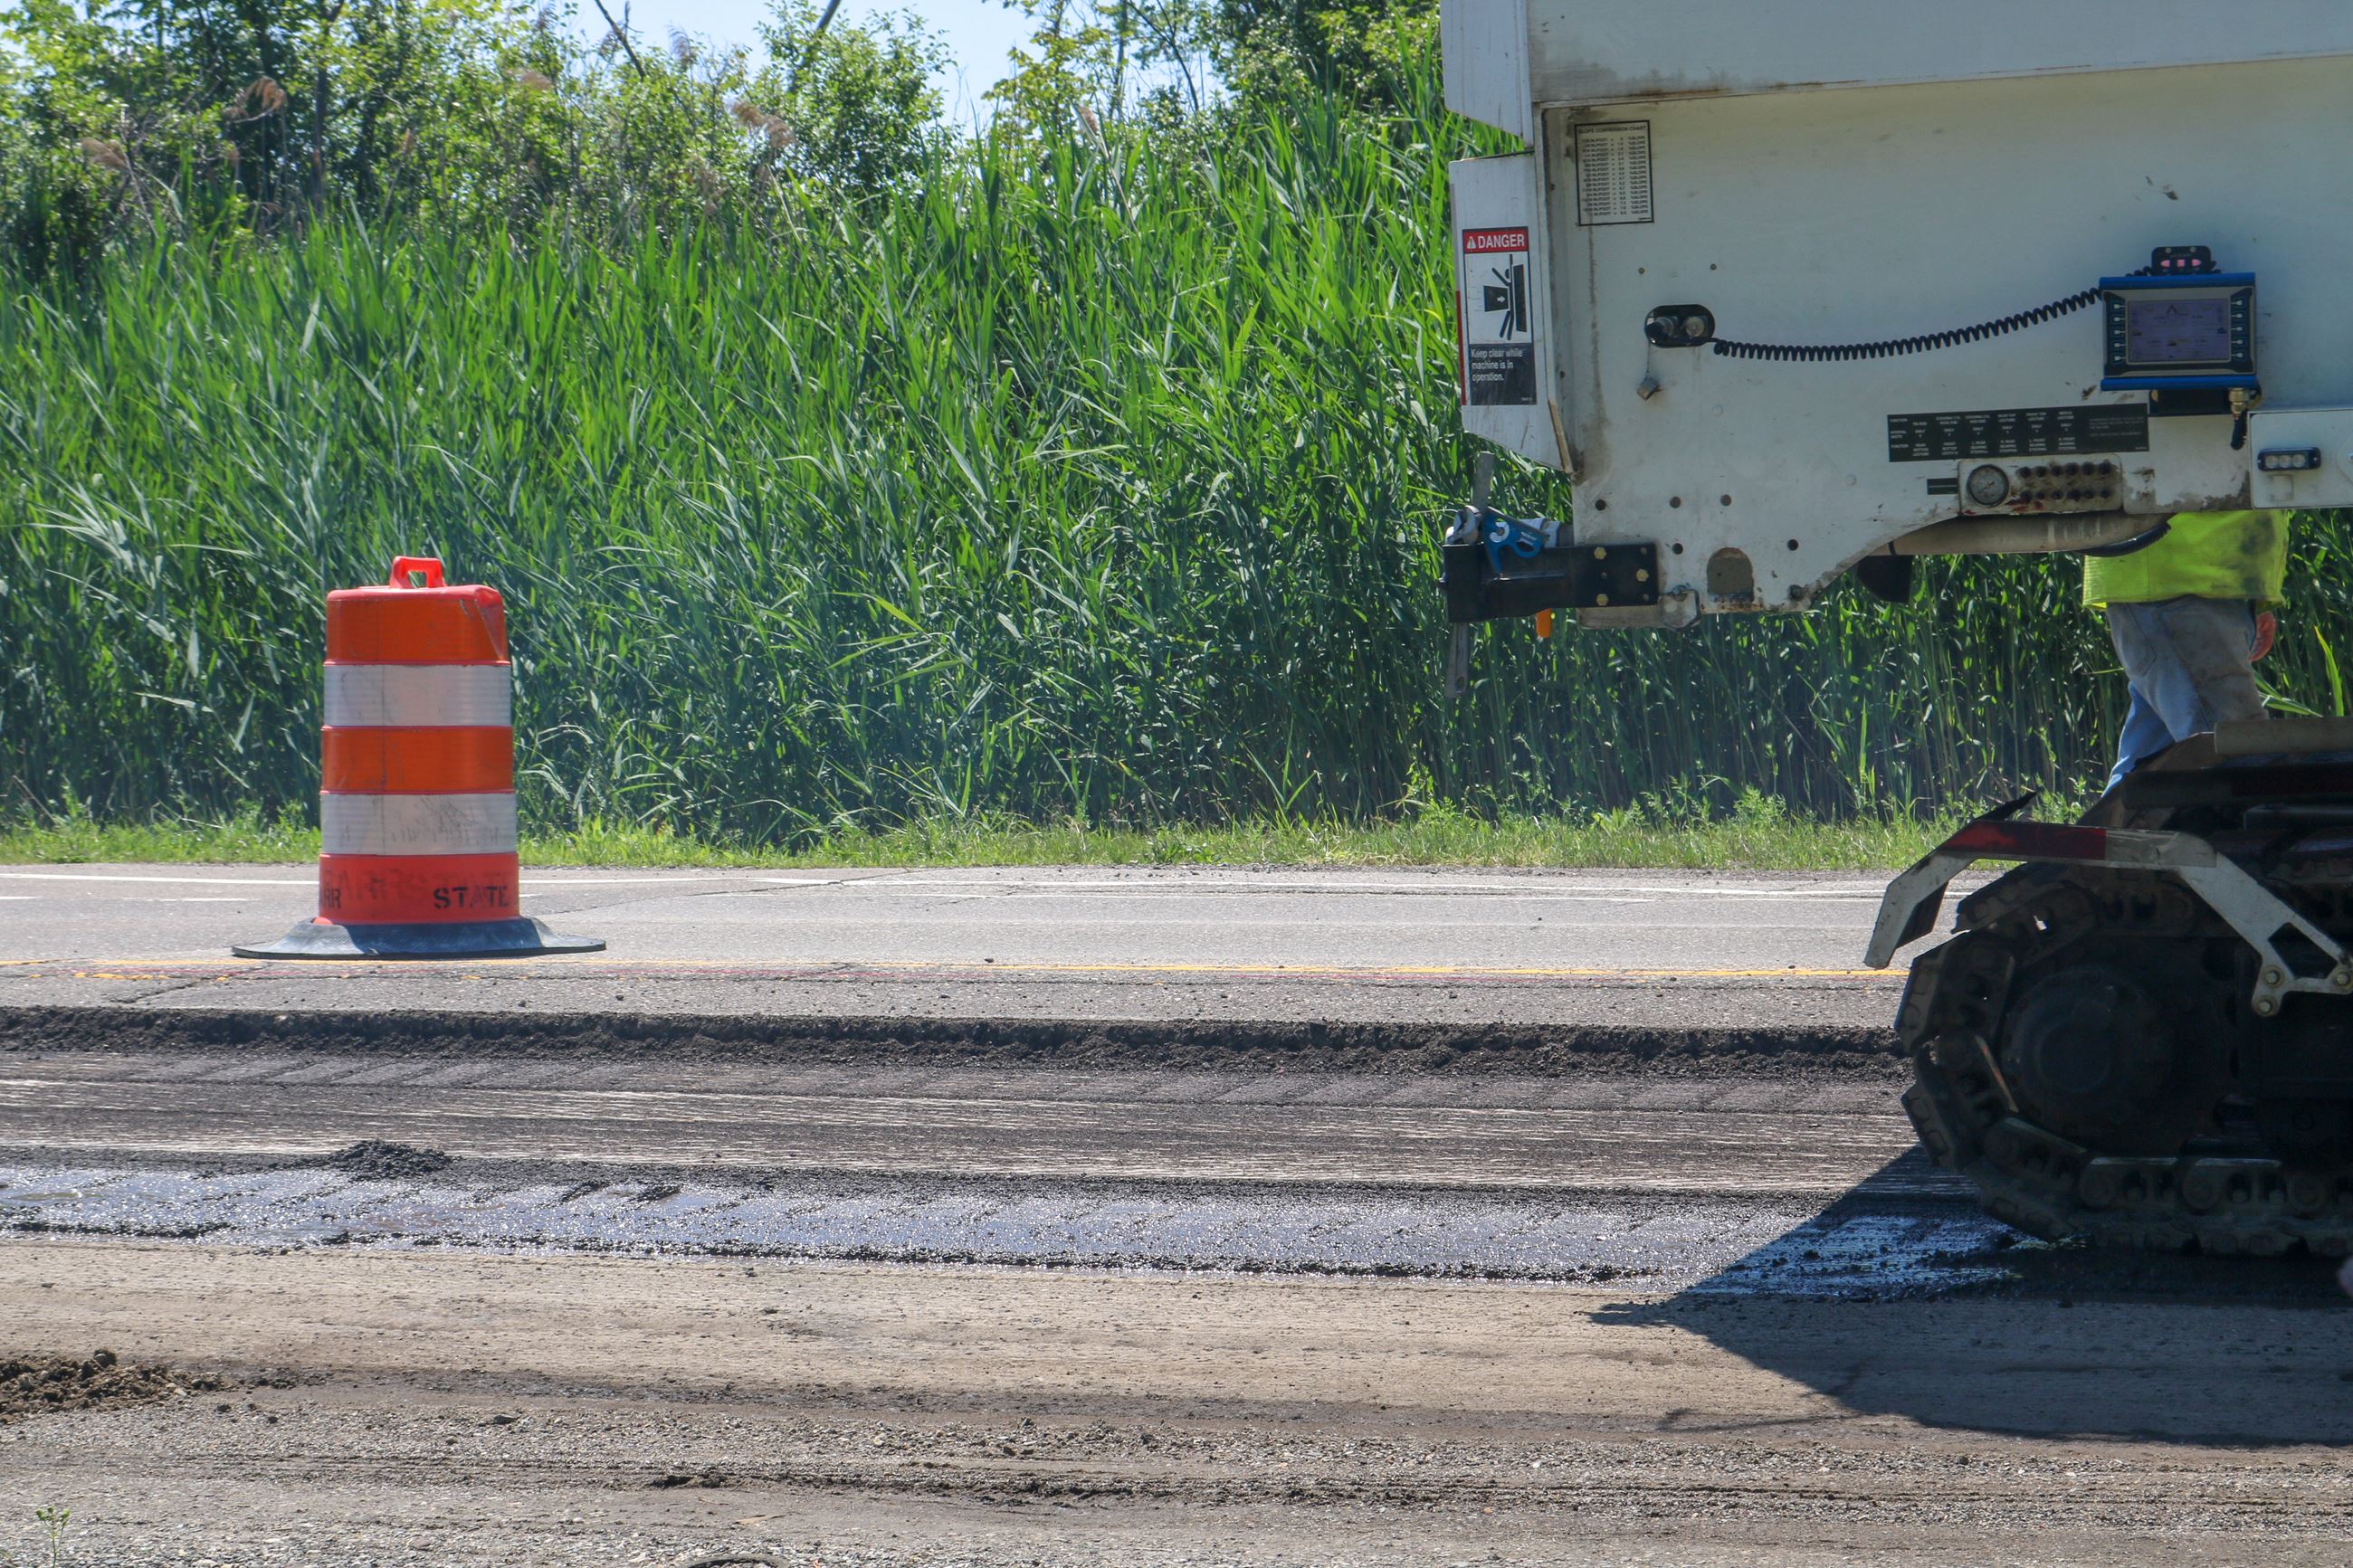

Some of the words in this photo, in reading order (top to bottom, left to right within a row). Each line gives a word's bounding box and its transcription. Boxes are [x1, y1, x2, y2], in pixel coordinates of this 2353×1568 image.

[1477, 233, 1525, 249] DANGER
[1471, 348, 1488, 359] Keep
[1489, 348, 1504, 357] clear
[1506, 347, 1522, 357] while
[1472, 360, 1499, 369] machine
[1500, 360, 1506, 369] is
[1507, 360, 1513, 369] in
[1472, 372, 1504, 384] operation.
[433, 886, 509, 910] STATE
